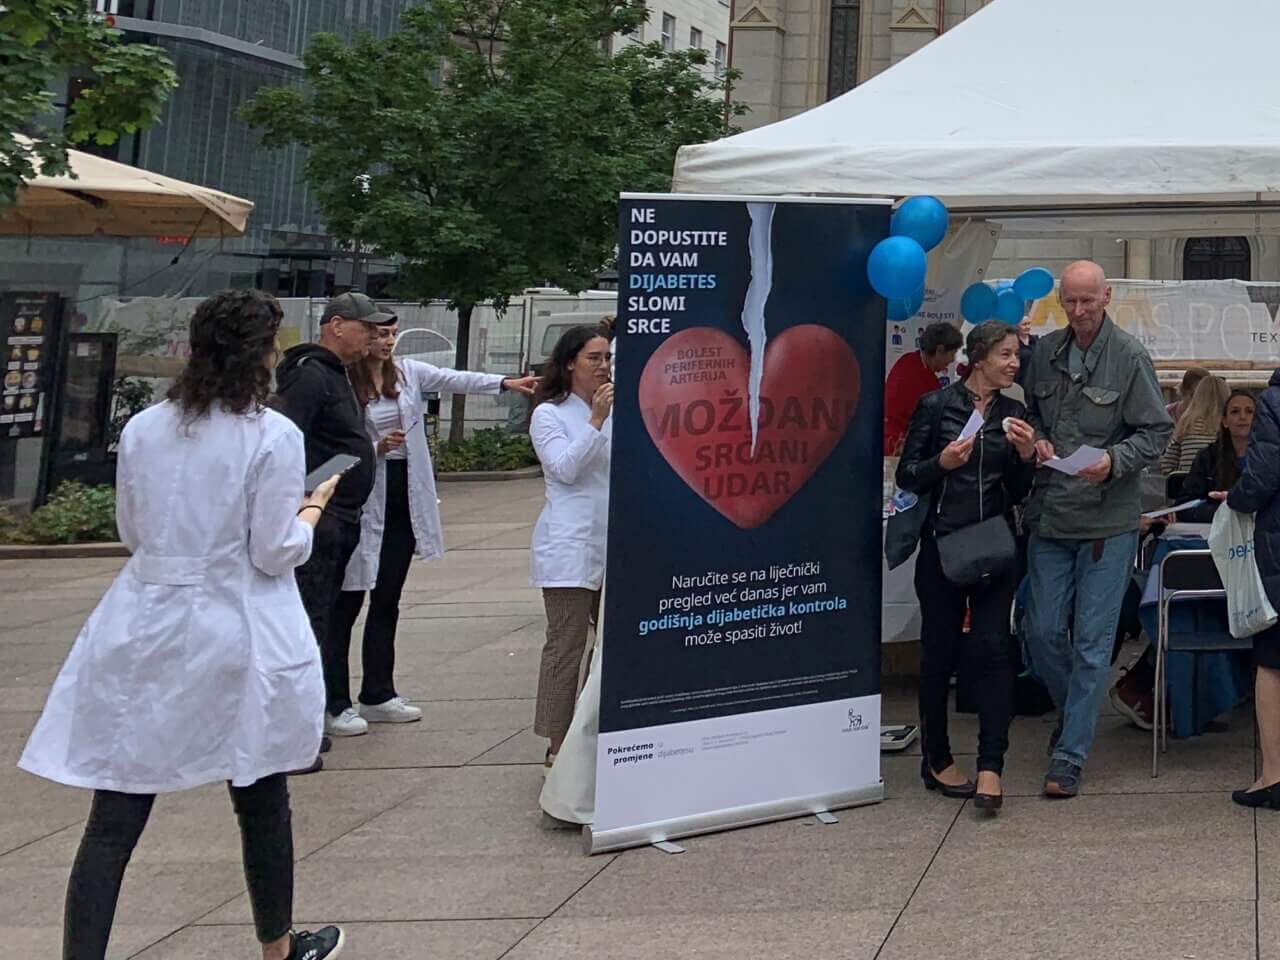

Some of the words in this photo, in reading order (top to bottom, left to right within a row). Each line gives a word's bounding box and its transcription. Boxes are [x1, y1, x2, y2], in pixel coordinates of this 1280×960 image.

[631, 208, 656, 223] NE
[630, 230, 728, 246] DOPUSTITE
[630, 252, 655, 267] DA
[659, 252, 698, 267] VAM
[629, 274, 717, 293] DIJABETES
[628, 296, 686, 311] SLOMI
[627, 318, 671, 334] SRCE
[677, 346, 723, 361] BOLEST
[664, 358, 736, 374] PERIFERNIH
[670, 371, 728, 386] ARTERIJA
[694, 433, 808, 472] SRČANI
[702, 471, 791, 500] UDAR
[672, 572, 729, 589] Naručite
[731, 572, 747, 584] se
[750, 569, 766, 581] na
[769, 561, 820, 583] liječnički
[659, 592, 711, 614] pregled
[714, 589, 738, 604] već
[740, 586, 779, 601] danas
[780, 584, 799, 601] jer
[800, 581, 828, 595] vam
[639, 613, 703, 636] godišnja
[706, 604, 786, 628] dijabetička
[789, 596, 847, 615] kontrola
[684, 630, 722, 647] može
[725, 626, 767, 645] spasiti
[769, 620, 803, 637] život!
[607, 743, 654, 755] Pokrećemo
[613, 753, 654, 766] promjene
